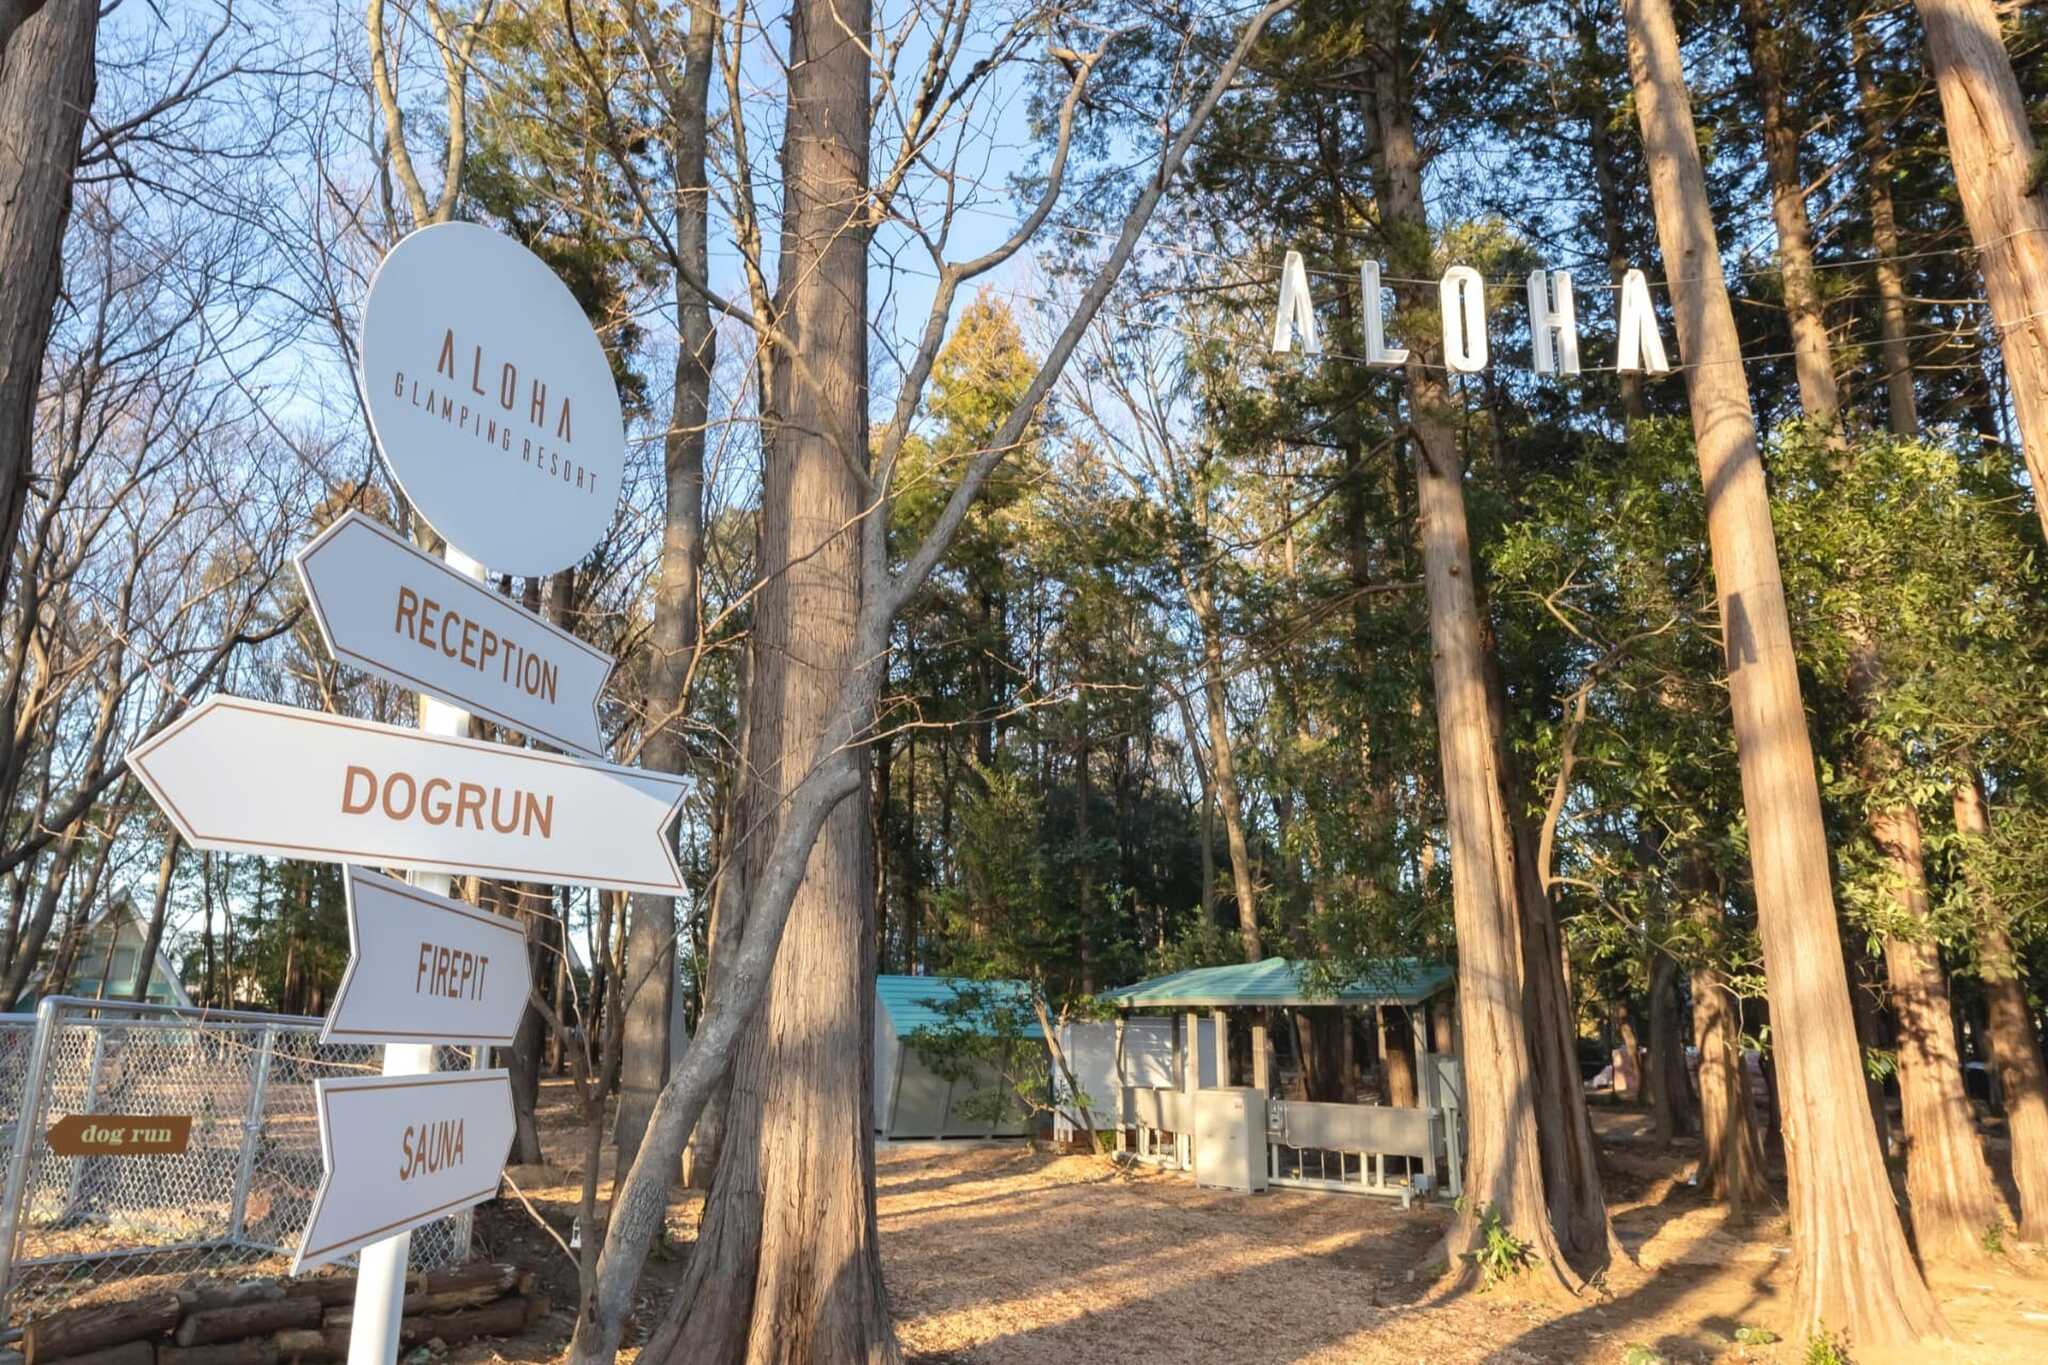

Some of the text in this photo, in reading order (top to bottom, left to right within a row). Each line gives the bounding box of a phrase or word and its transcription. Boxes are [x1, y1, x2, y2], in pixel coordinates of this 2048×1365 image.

[1272, 250, 1670, 375] ALOHA
[394, 371, 597, 494] GLAMPING RESORT
[437, 328, 572, 443] ALOHA
[395, 585, 558, 704] RECEPTION
[342, 765, 554, 839] DOGRUN
[416, 942, 489, 1002] FIREPIT
[81, 1125, 172, 1146] dog run
[400, 1118, 464, 1181] SAUNA
